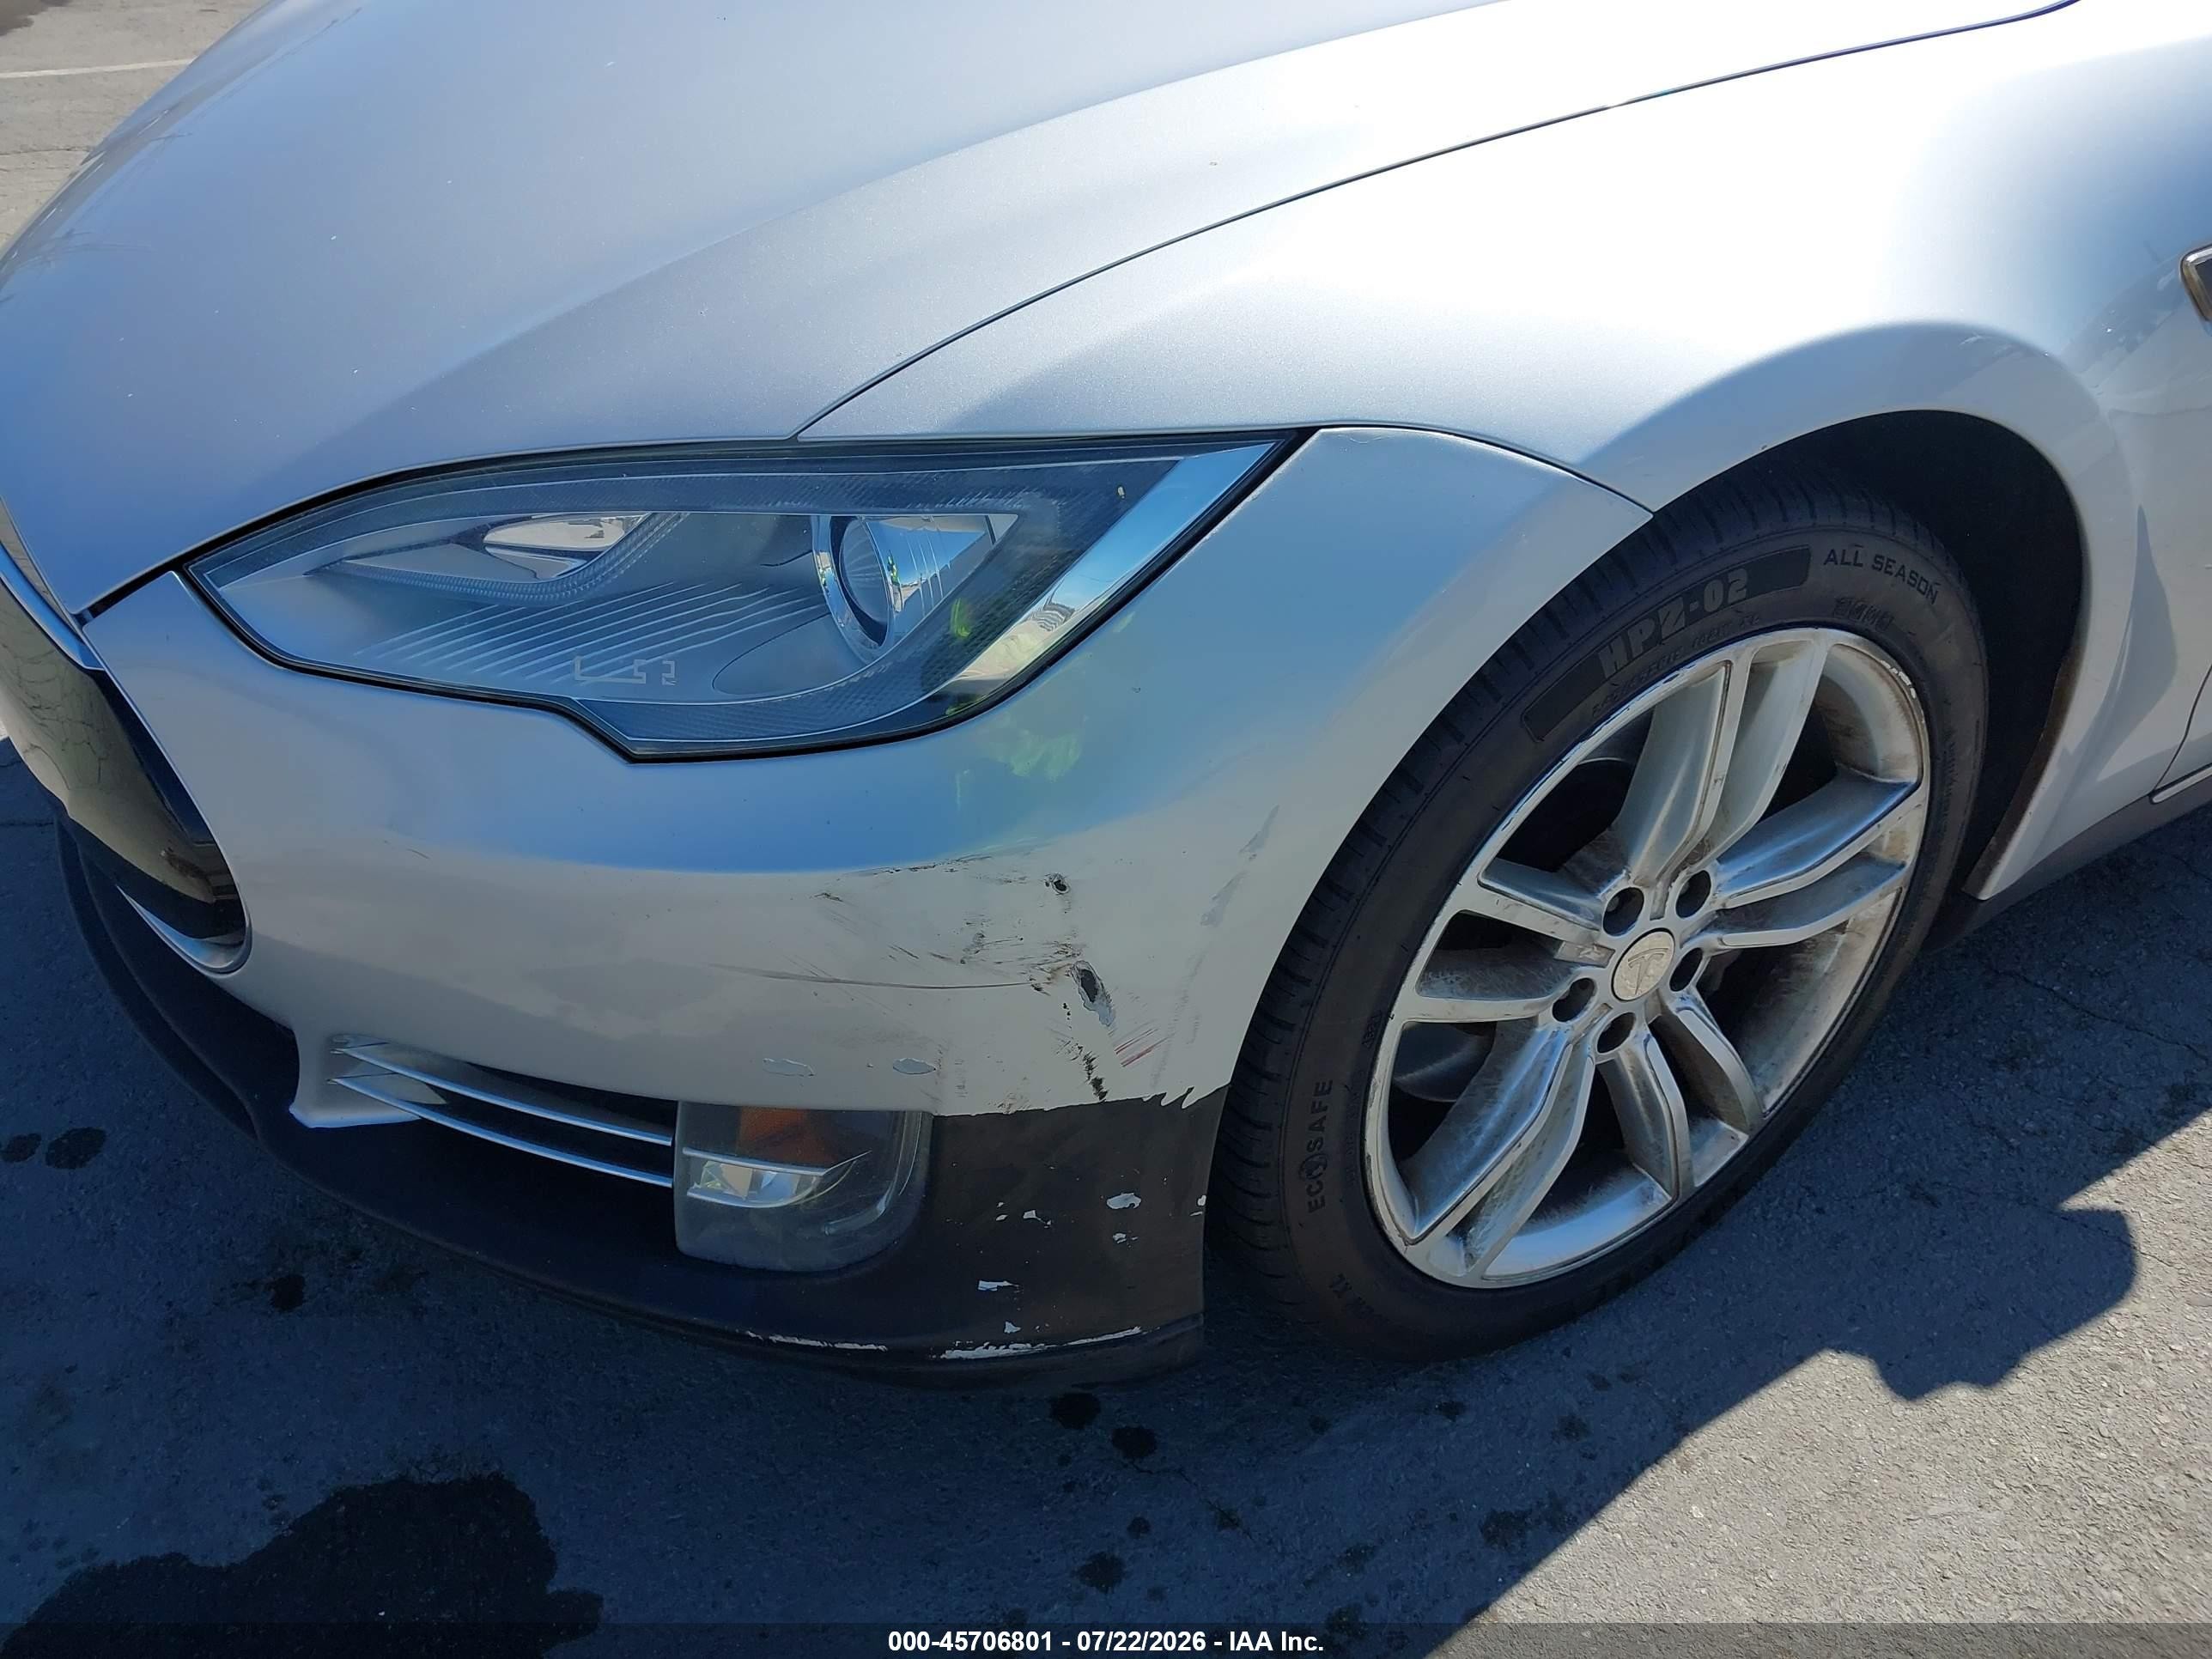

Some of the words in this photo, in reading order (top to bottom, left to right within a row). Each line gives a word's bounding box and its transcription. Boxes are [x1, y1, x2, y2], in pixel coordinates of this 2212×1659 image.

[1823, 549, 1863, 568] ALL
[1871, 554, 1939, 605] SEASON
[1300, 1079, 1334, 1213] ECOSAFE
